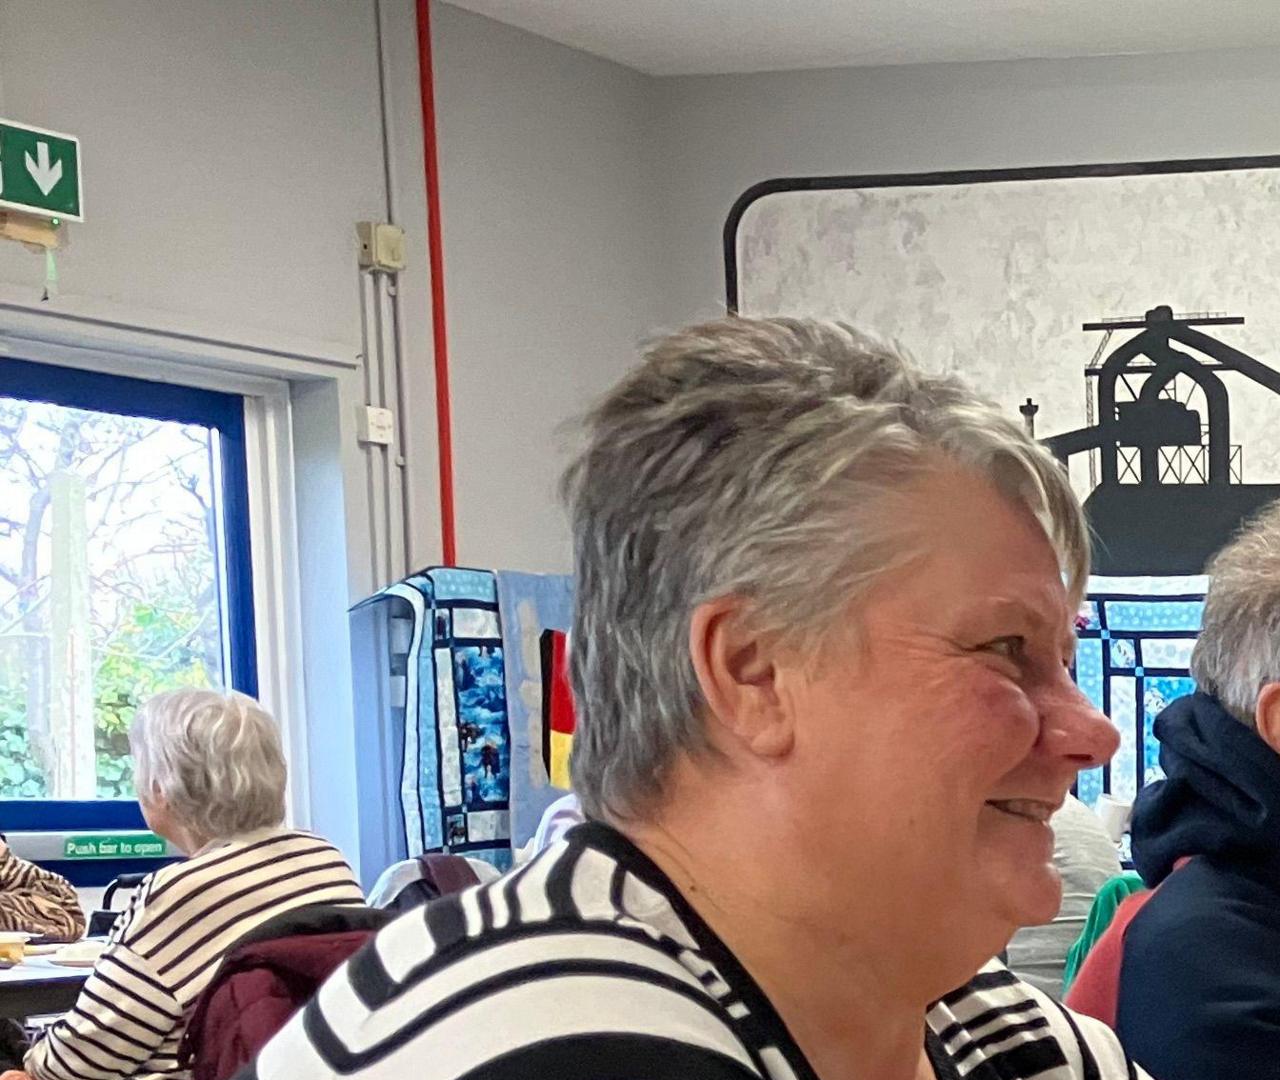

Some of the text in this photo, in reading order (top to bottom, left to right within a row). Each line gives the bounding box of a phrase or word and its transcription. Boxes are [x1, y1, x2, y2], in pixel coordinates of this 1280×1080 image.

[67, 841, 163, 856] Push bar to open
